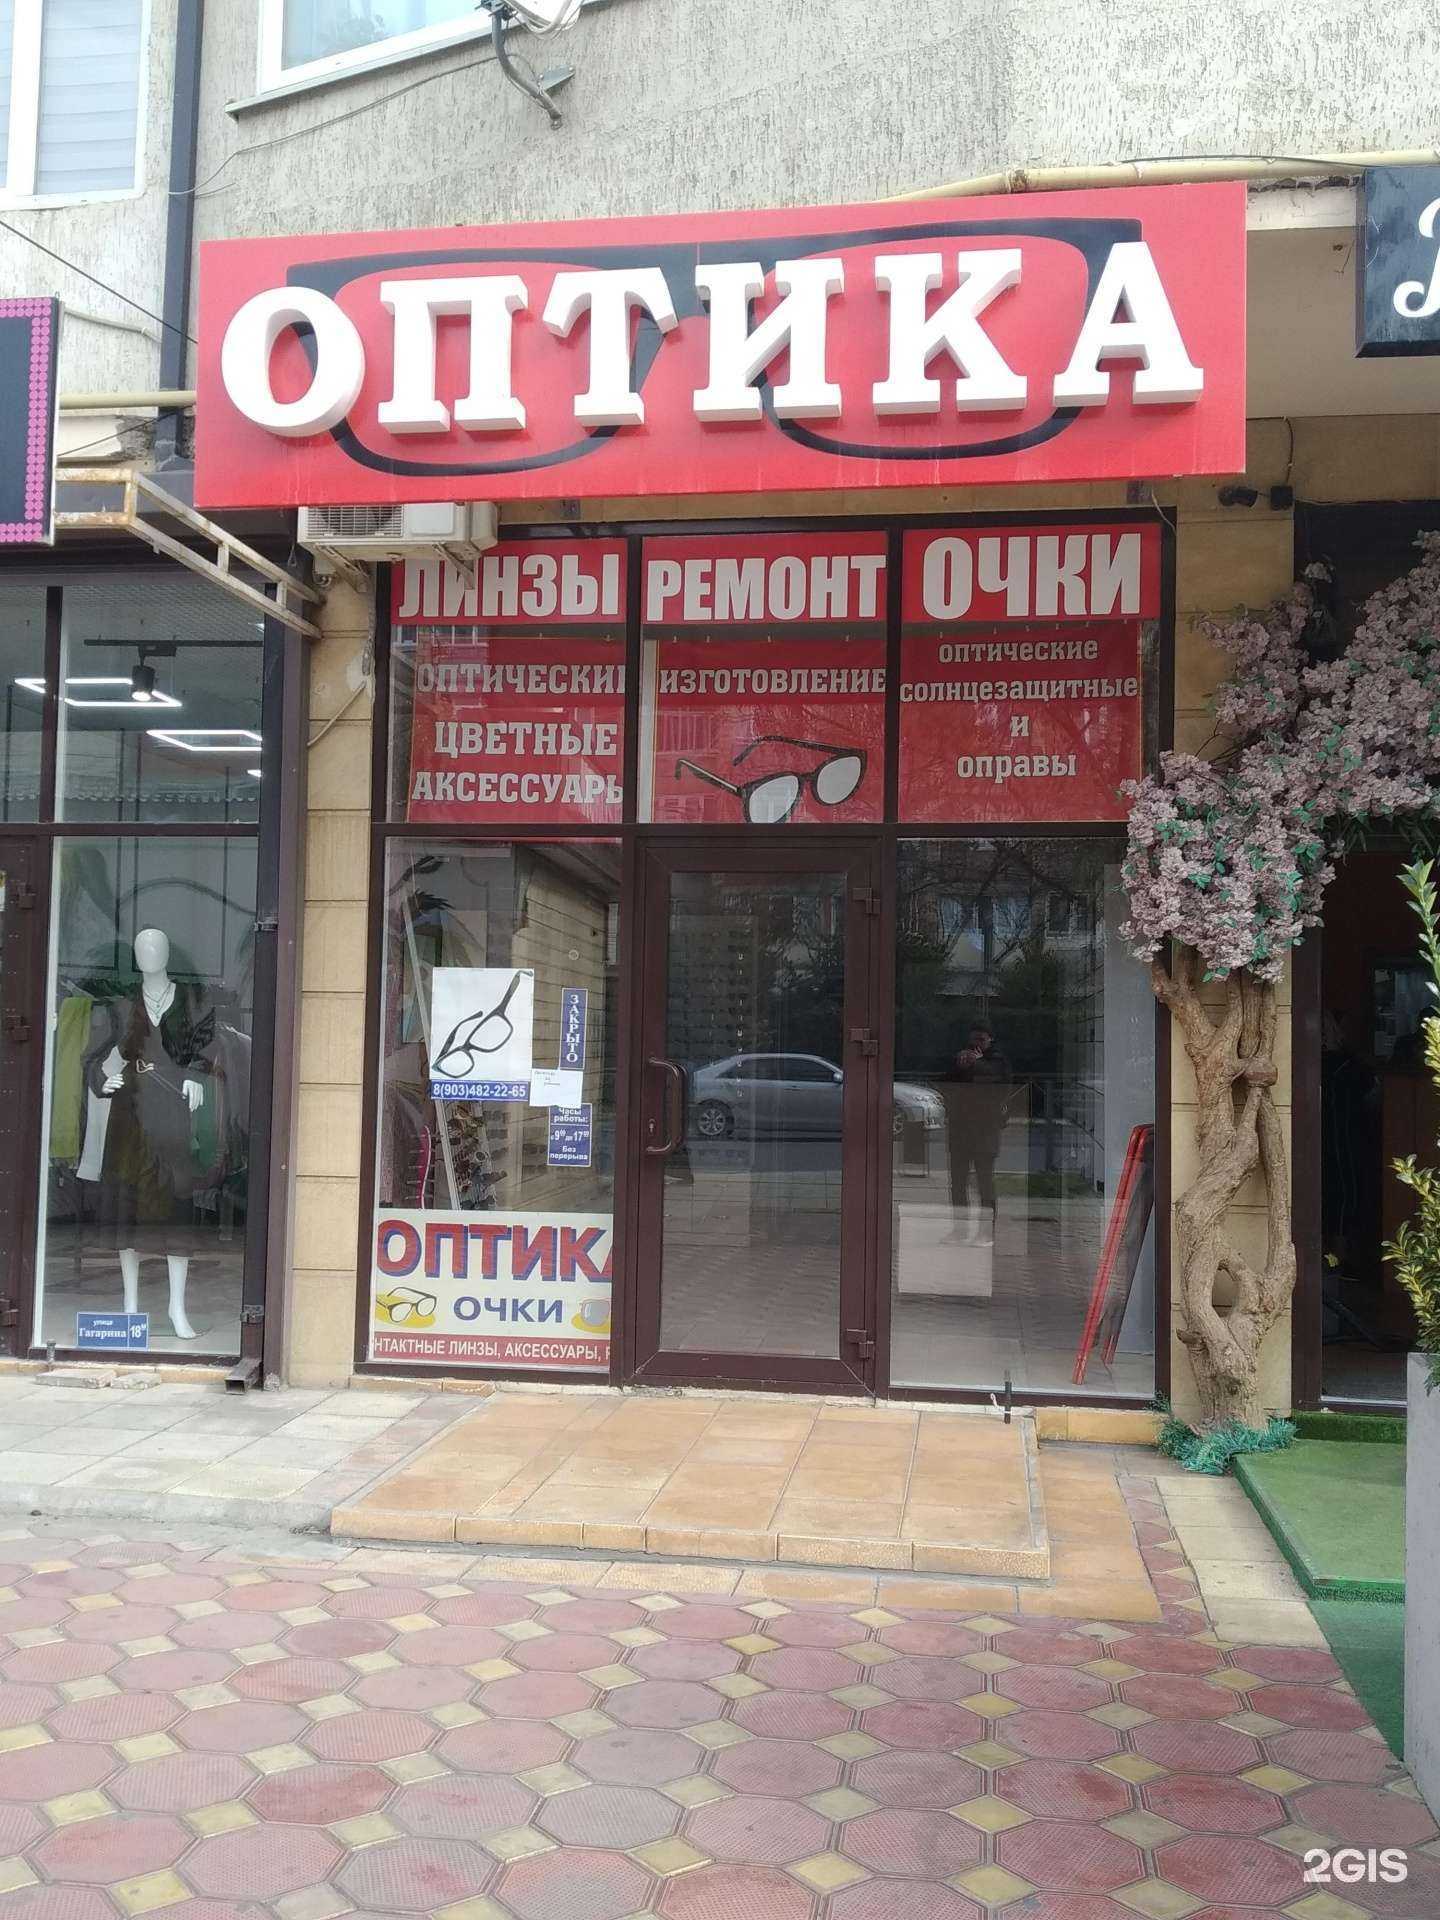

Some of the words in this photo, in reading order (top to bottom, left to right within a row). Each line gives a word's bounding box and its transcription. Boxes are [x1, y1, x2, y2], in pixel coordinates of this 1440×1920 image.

[220, 241, 1204, 437] ОПТИКА
[399, 554, 619, 617] ЛИНЗЫ
[646, 555, 887, 621] РЕМОНТ
[923, 533, 1141, 619] ОЧКИ
[939, 640, 1098, 663] оптические
[660, 668, 886, 694] ИЗГОТОВЛЕНИЕ
[900, 677, 1138, 703] солнцезащитные
[435, 721, 618, 758] ЦВЕТНЫЕ
[957, 754, 1077, 784] оправы
[566, 994, 580, 1063] ЗАКРЫТО
[433, 1083, 526, 1098] 8(903)482-22-65
[377, 1219, 612, 1283] ОПТИК
[79, 1328, 126, 1339] Гагарина
[448, 1341, 501, 1359] ЛИНЗЫ,
[505, 1342, 600, 1361] АКСЕССУАРЫ,
